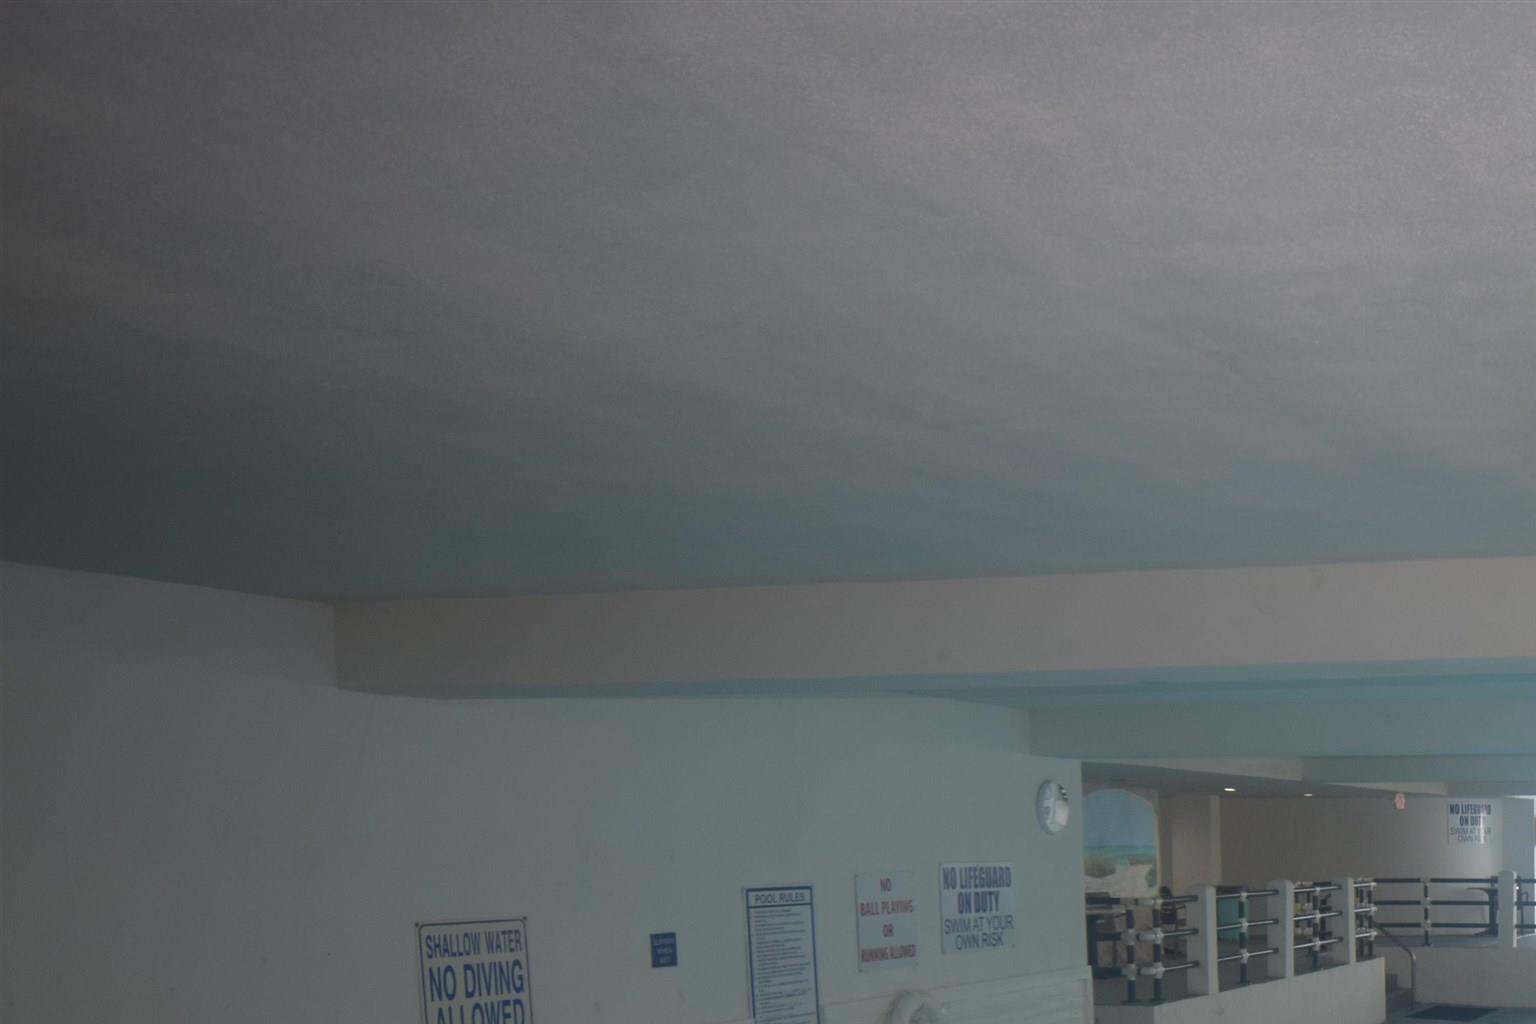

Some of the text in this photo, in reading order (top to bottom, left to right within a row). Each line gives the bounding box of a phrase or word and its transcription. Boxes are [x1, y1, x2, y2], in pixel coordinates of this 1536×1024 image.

[1450, 804, 1460, 815] NO
[1460, 816, 1484, 826] ON DUT
[880, 878, 892, 892] NO
[942, 866, 1012, 890] NO LIFEGUARD
[754, 892, 805, 904] POOL RULES
[860, 899, 914, 916] BALL PLAYING
[958, 890, 1000, 914] ON DUTY
[943, 914, 1014, 935] SWIM AT YOUR
[425, 929, 522, 959] SHALLOW WATER
[955, 932, 1004, 951] OWN RISK
[428, 959, 525, 1002] NO DIVING
